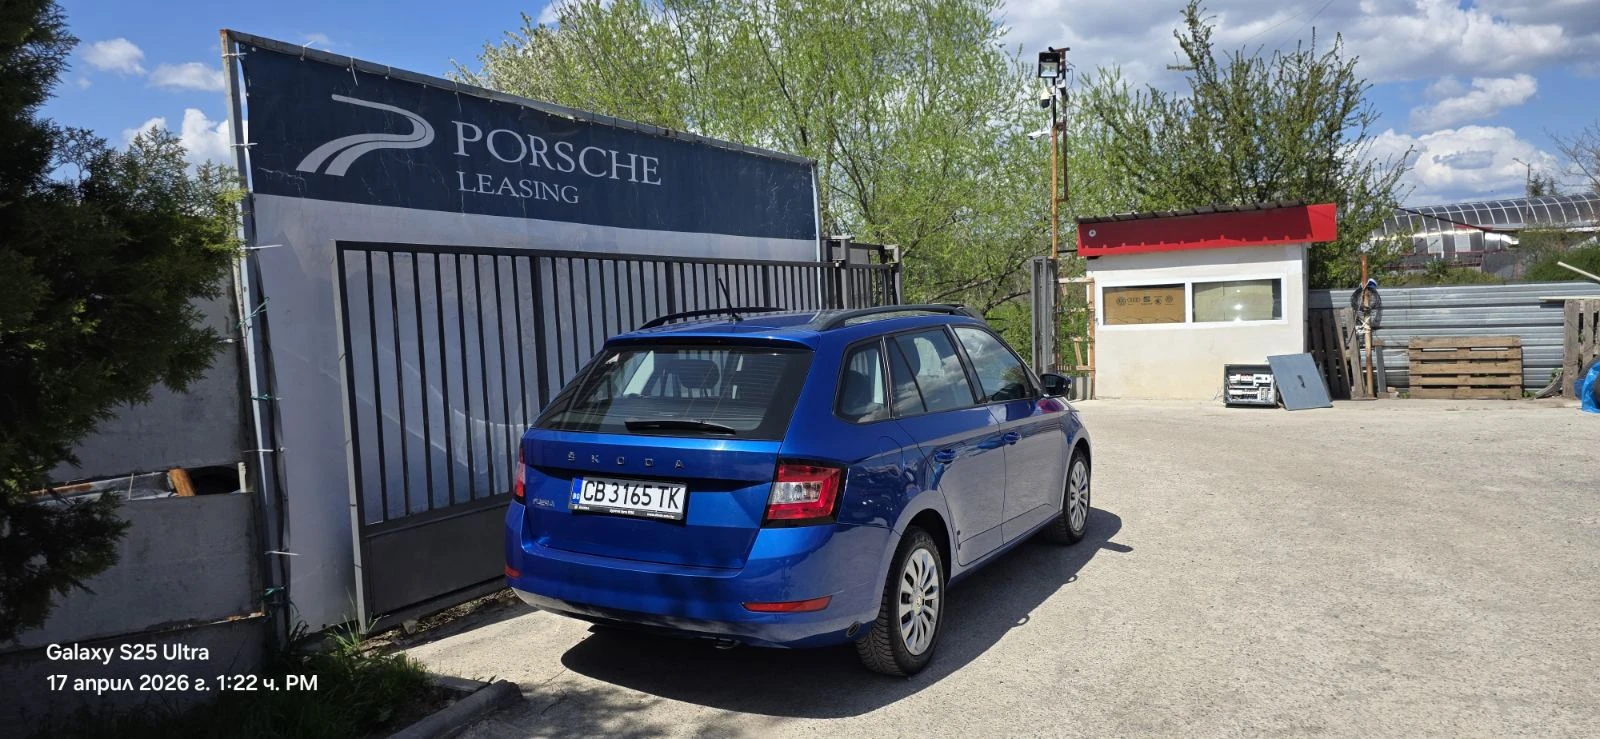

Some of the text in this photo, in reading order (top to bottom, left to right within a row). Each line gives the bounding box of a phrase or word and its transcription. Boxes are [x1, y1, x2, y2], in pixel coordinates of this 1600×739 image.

[451, 120, 662, 186] PORSCHE
[456, 170, 579, 204] LEASING
[583, 480, 681, 510] CB 3165 TK
